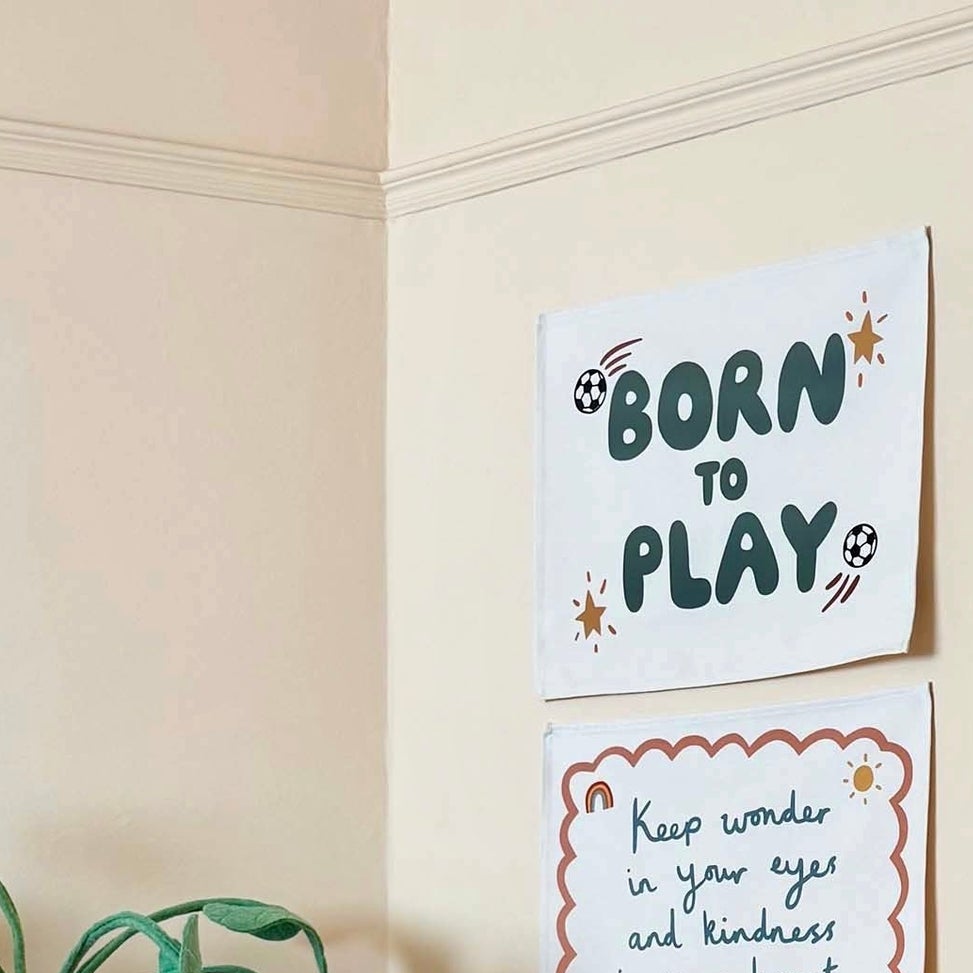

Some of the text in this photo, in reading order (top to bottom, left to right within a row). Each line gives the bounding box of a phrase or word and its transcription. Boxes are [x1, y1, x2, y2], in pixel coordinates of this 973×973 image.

[608, 333, 846, 461] BORN
[694, 457, 748, 506] TO
[622, 501, 837, 613] PLAY
[633, 789, 832, 854] Keep wonder
[626, 855, 837, 915] in your eyes
[627, 906, 837, 952] and kindness
